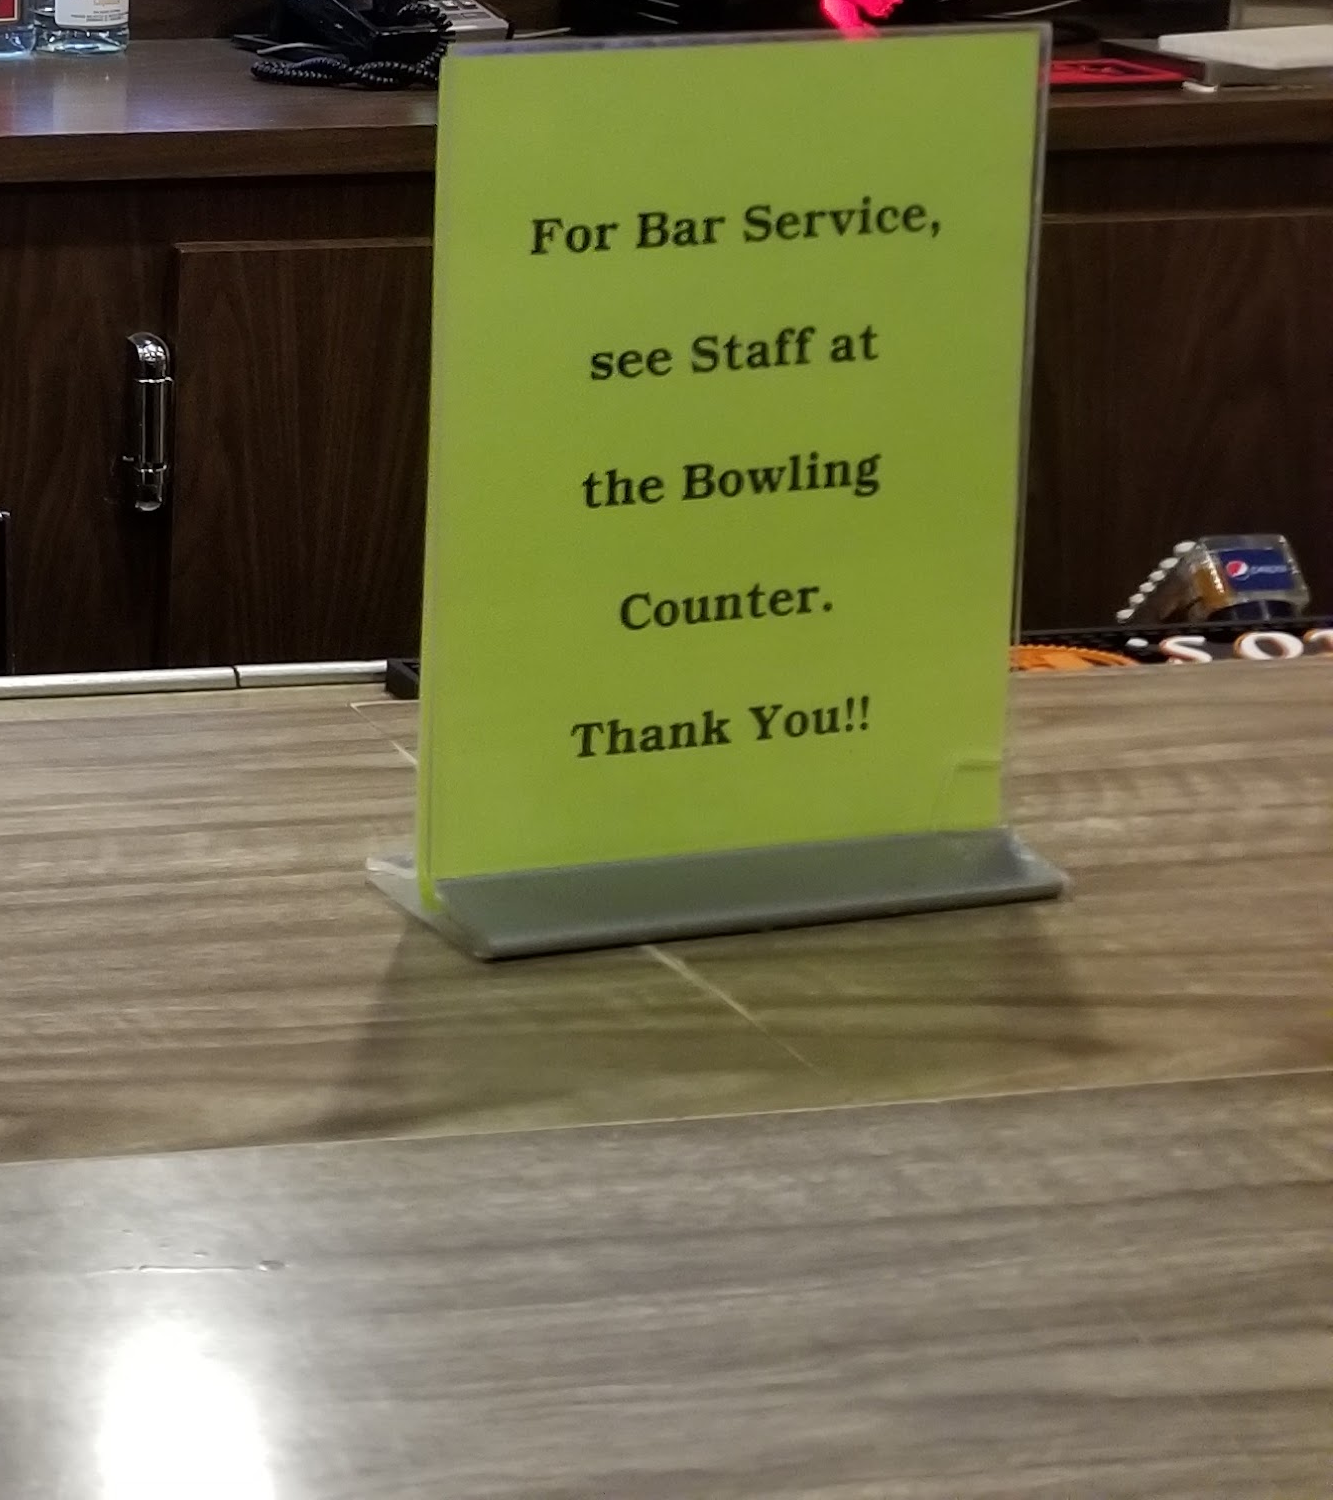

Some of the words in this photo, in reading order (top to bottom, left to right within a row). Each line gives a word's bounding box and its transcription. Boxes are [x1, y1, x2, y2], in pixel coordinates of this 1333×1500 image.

[529, 215, 616, 256] For
[635, 210, 725, 250] Bar
[743, 196, 943, 244] Service,
[589, 346, 673, 381] see
[690, 326, 818, 374] Staff
[829, 324, 880, 365] at
[581, 468, 665, 508] the
[681, 451, 882, 506] Bowling
[618, 583, 835, 632] Counter.
[570, 710, 733, 760] Thank
[749, 694, 872, 741] You!!
